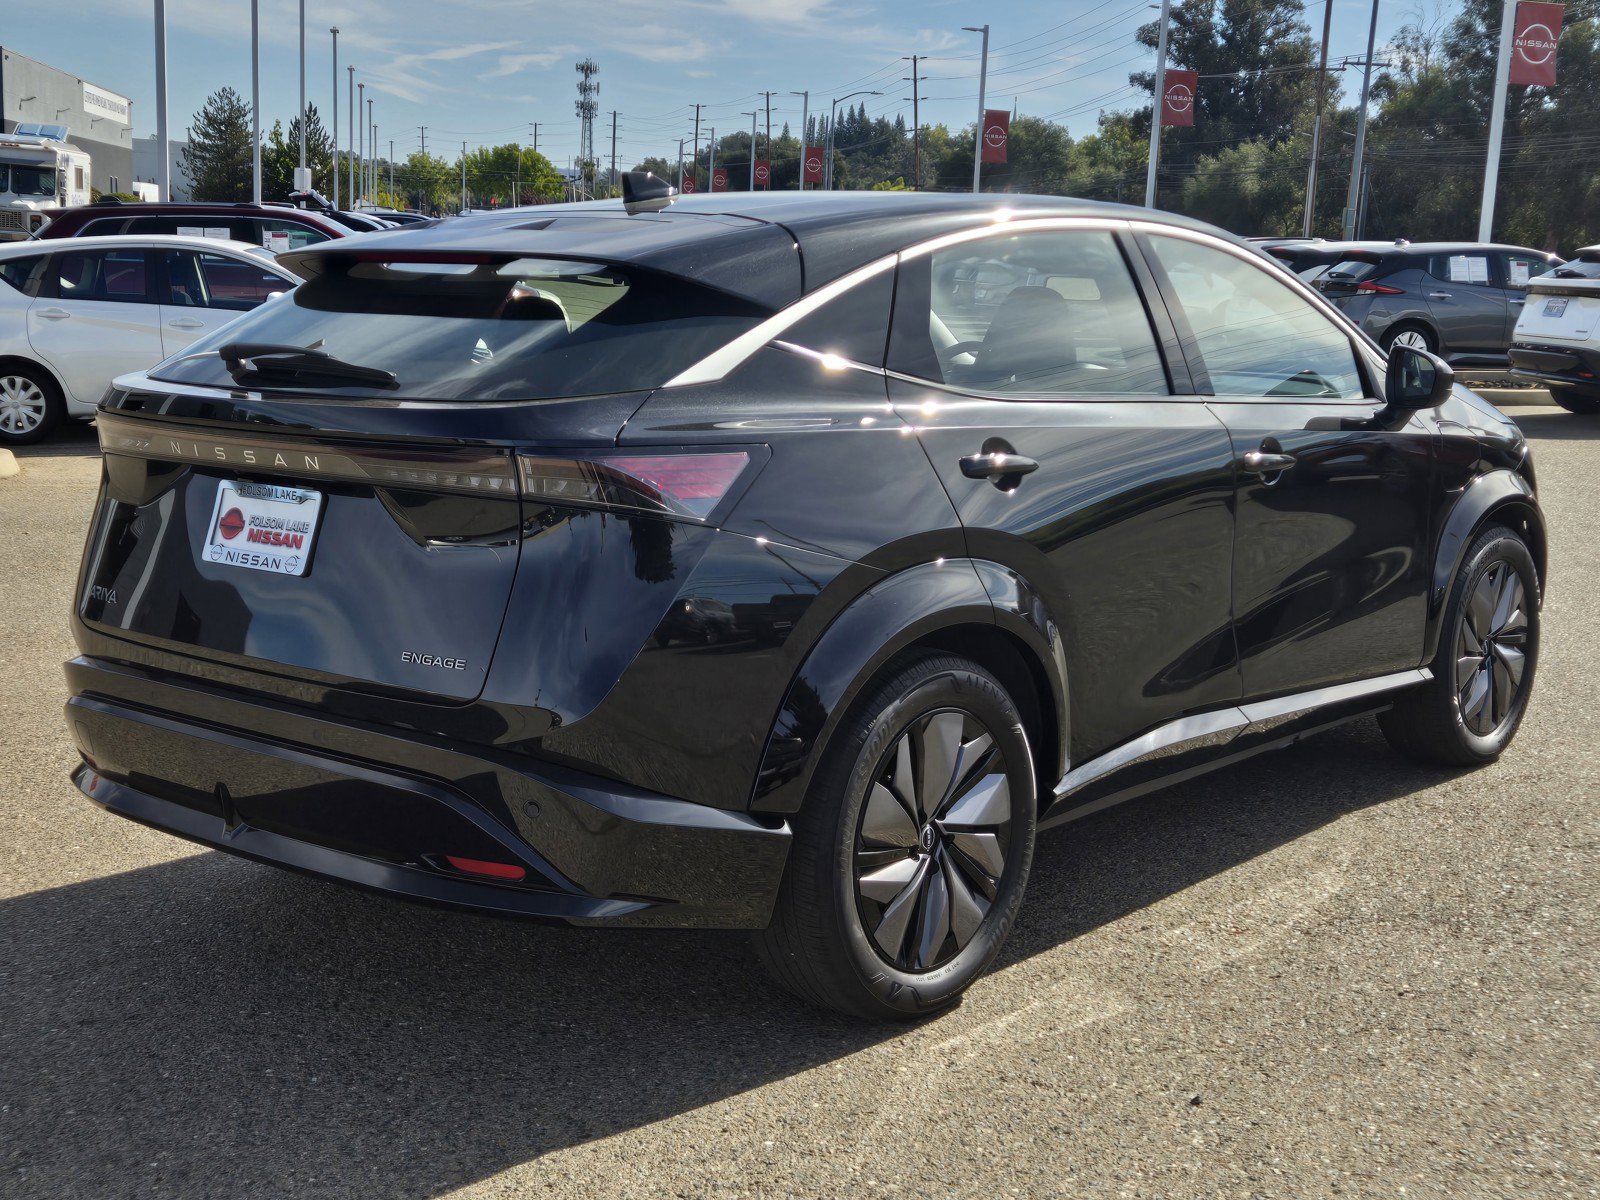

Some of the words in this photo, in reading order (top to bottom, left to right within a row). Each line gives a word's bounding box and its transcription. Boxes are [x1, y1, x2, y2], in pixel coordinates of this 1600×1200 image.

[1515, 39, 1557, 49] NISSAN
[1165, 94, 1194, 102] NISSAN
[170, 440, 320, 470] NISSAN
[242, 485, 274, 498] FOLSOM
[275, 488, 297, 501] LAKE
[249, 514, 284, 531] FOLSOM
[286, 519, 310, 534] LAKE
[246, 528, 304, 549] NISSAN
[225, 550, 281, 570] NISSAN
[91, 584, 117, 604] ARIYA
[401, 651, 467, 670] ENGAGE
